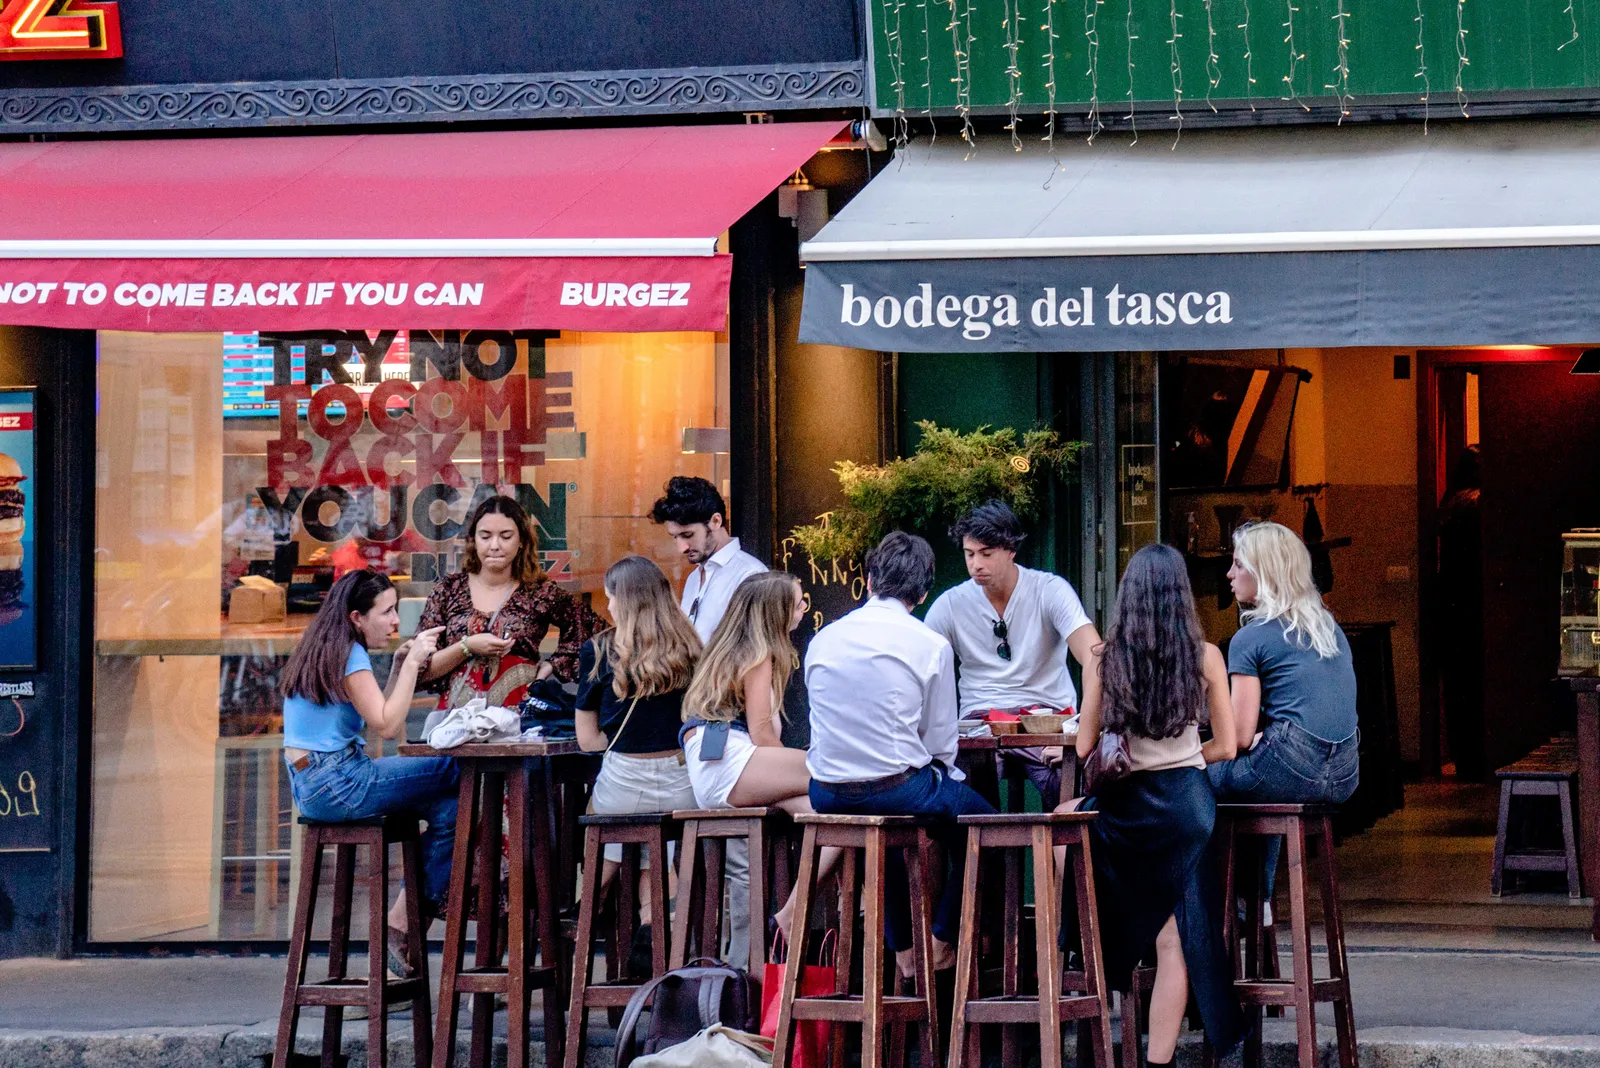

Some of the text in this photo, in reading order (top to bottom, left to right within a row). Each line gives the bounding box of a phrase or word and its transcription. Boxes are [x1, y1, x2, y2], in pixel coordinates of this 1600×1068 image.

[63, 282, 107, 305] TO
[113, 282, 207, 307] COME
[211, 282, 301, 306] BACK
[305, 282, 335, 306] IF
[341, 282, 408, 306] YOU
[413, 282, 484, 306] CAN
[560, 282, 690, 307] BURGEZ
[840, 283, 1233, 340] bodega del tasca
[259, 331, 399, 387] TRY
[409, 330, 561, 381] NOT
[264, 371, 574, 441] TO COME
[267, 430, 547, 490] BACK IF
[256, 484, 407, 541] YOU
